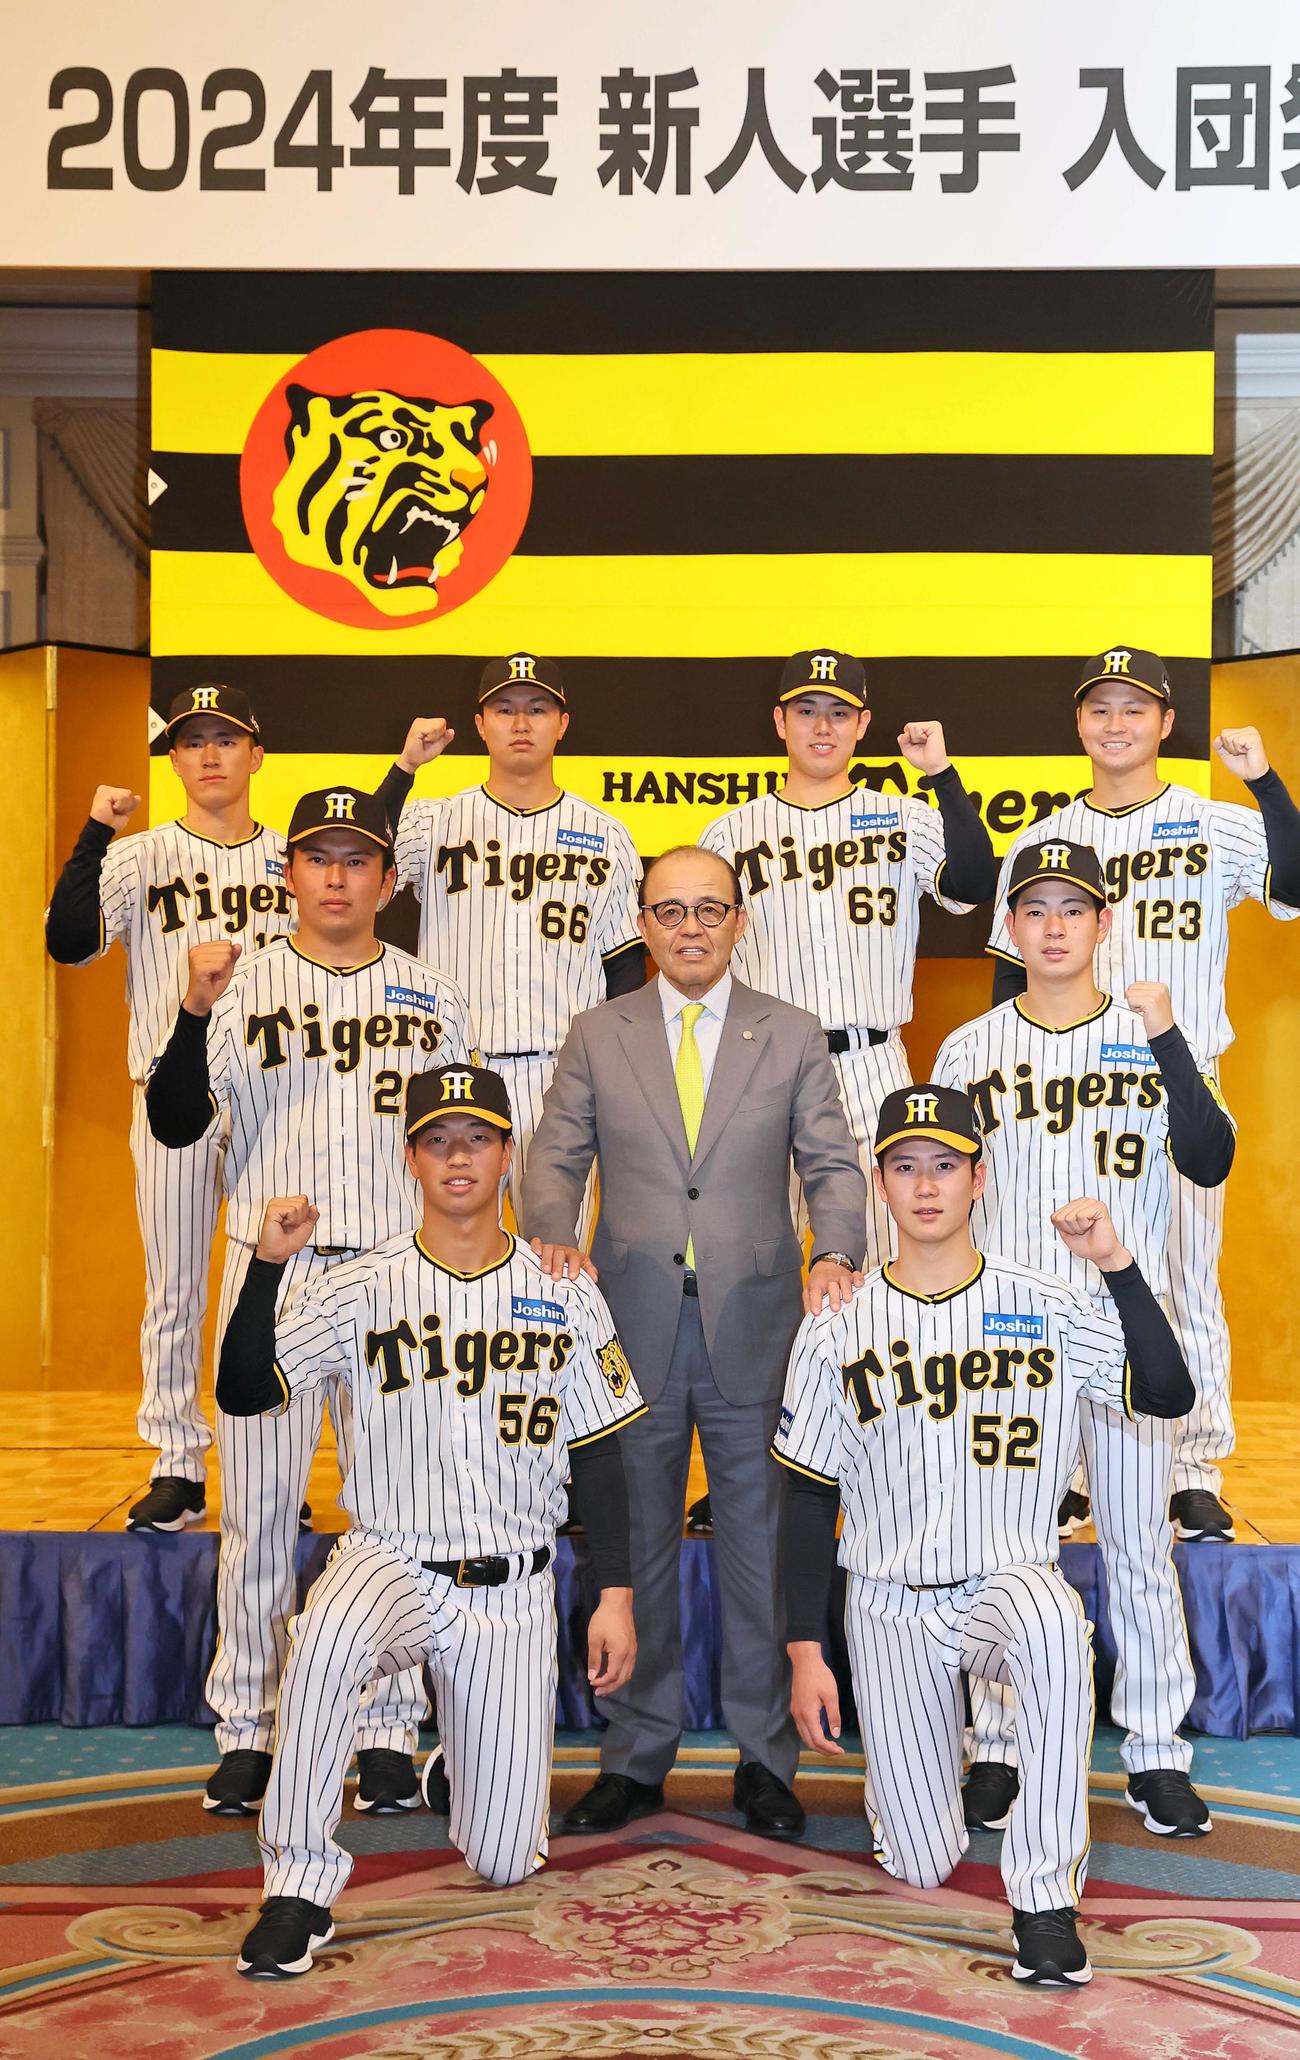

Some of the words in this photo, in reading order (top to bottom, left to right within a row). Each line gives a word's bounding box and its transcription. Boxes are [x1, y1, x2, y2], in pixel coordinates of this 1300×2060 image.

[46, 65, 561, 196] 2024年度
[596, 65, 1022, 196] 新人選手
[1062, 64, 1300, 193] 入団
[602, 771, 788, 805] HANSHI
[558, 831, 603, 849] Joshin
[852, 815, 898, 829] Joshin
[1153, 823, 1199, 838] Joshin
[437, 839, 611, 901] Tigers
[734, 829, 907, 897] Tigers
[1104, 842, 1210, 905] gers
[148, 872, 297, 933] Tiger
[540, 900, 589, 944] 66
[848, 886, 897, 928] 63
[1134, 899, 1202, 942] 123
[385, 987, 435, 1010] Joshin
[246, 1003, 443, 1073] Tigers
[1101, 1047, 1155, 1063] Joshin
[374, 1069, 404, 1116] 2
[967, 1062, 1164, 1137] Tigers
[1093, 1129, 1146, 1180] 19
[513, 1300, 565, 1322] Joshin
[984, 1316, 1042, 1336] Joshin
[365, 1312, 574, 1397] Tigers
[842, 1340, 1056, 1426] Tigers
[498, 1393, 560, 1447] 56
[972, 1413, 1041, 1469] 52
